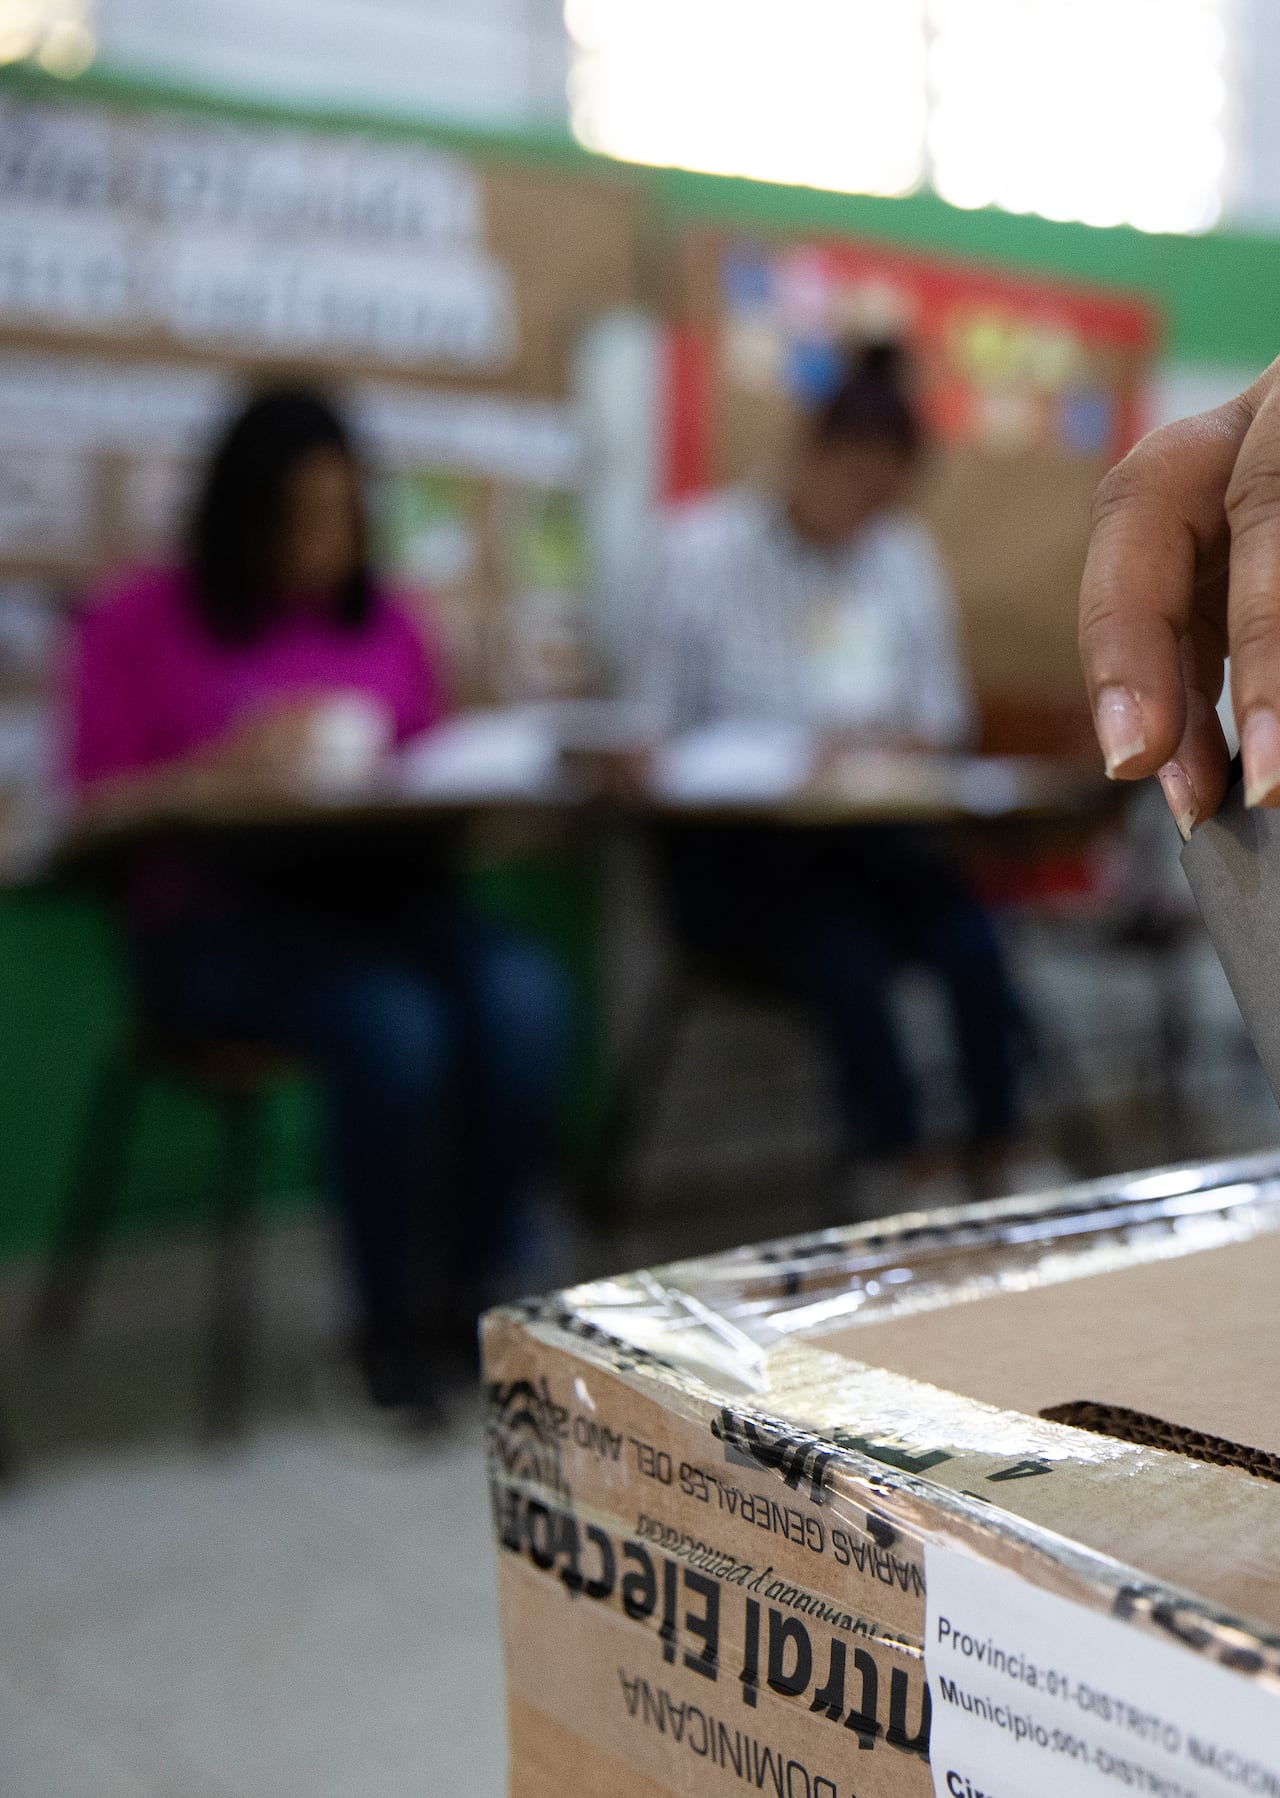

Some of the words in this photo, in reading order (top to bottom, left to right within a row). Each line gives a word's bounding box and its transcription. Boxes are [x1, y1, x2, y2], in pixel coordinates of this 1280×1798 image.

[629, 1435, 674, 1485] DEL
[679, 1461, 826, 1554] GENERALES
[831, 1529, 928, 1598] NARIAS
[740, 1598, 931, 1763] ntral
